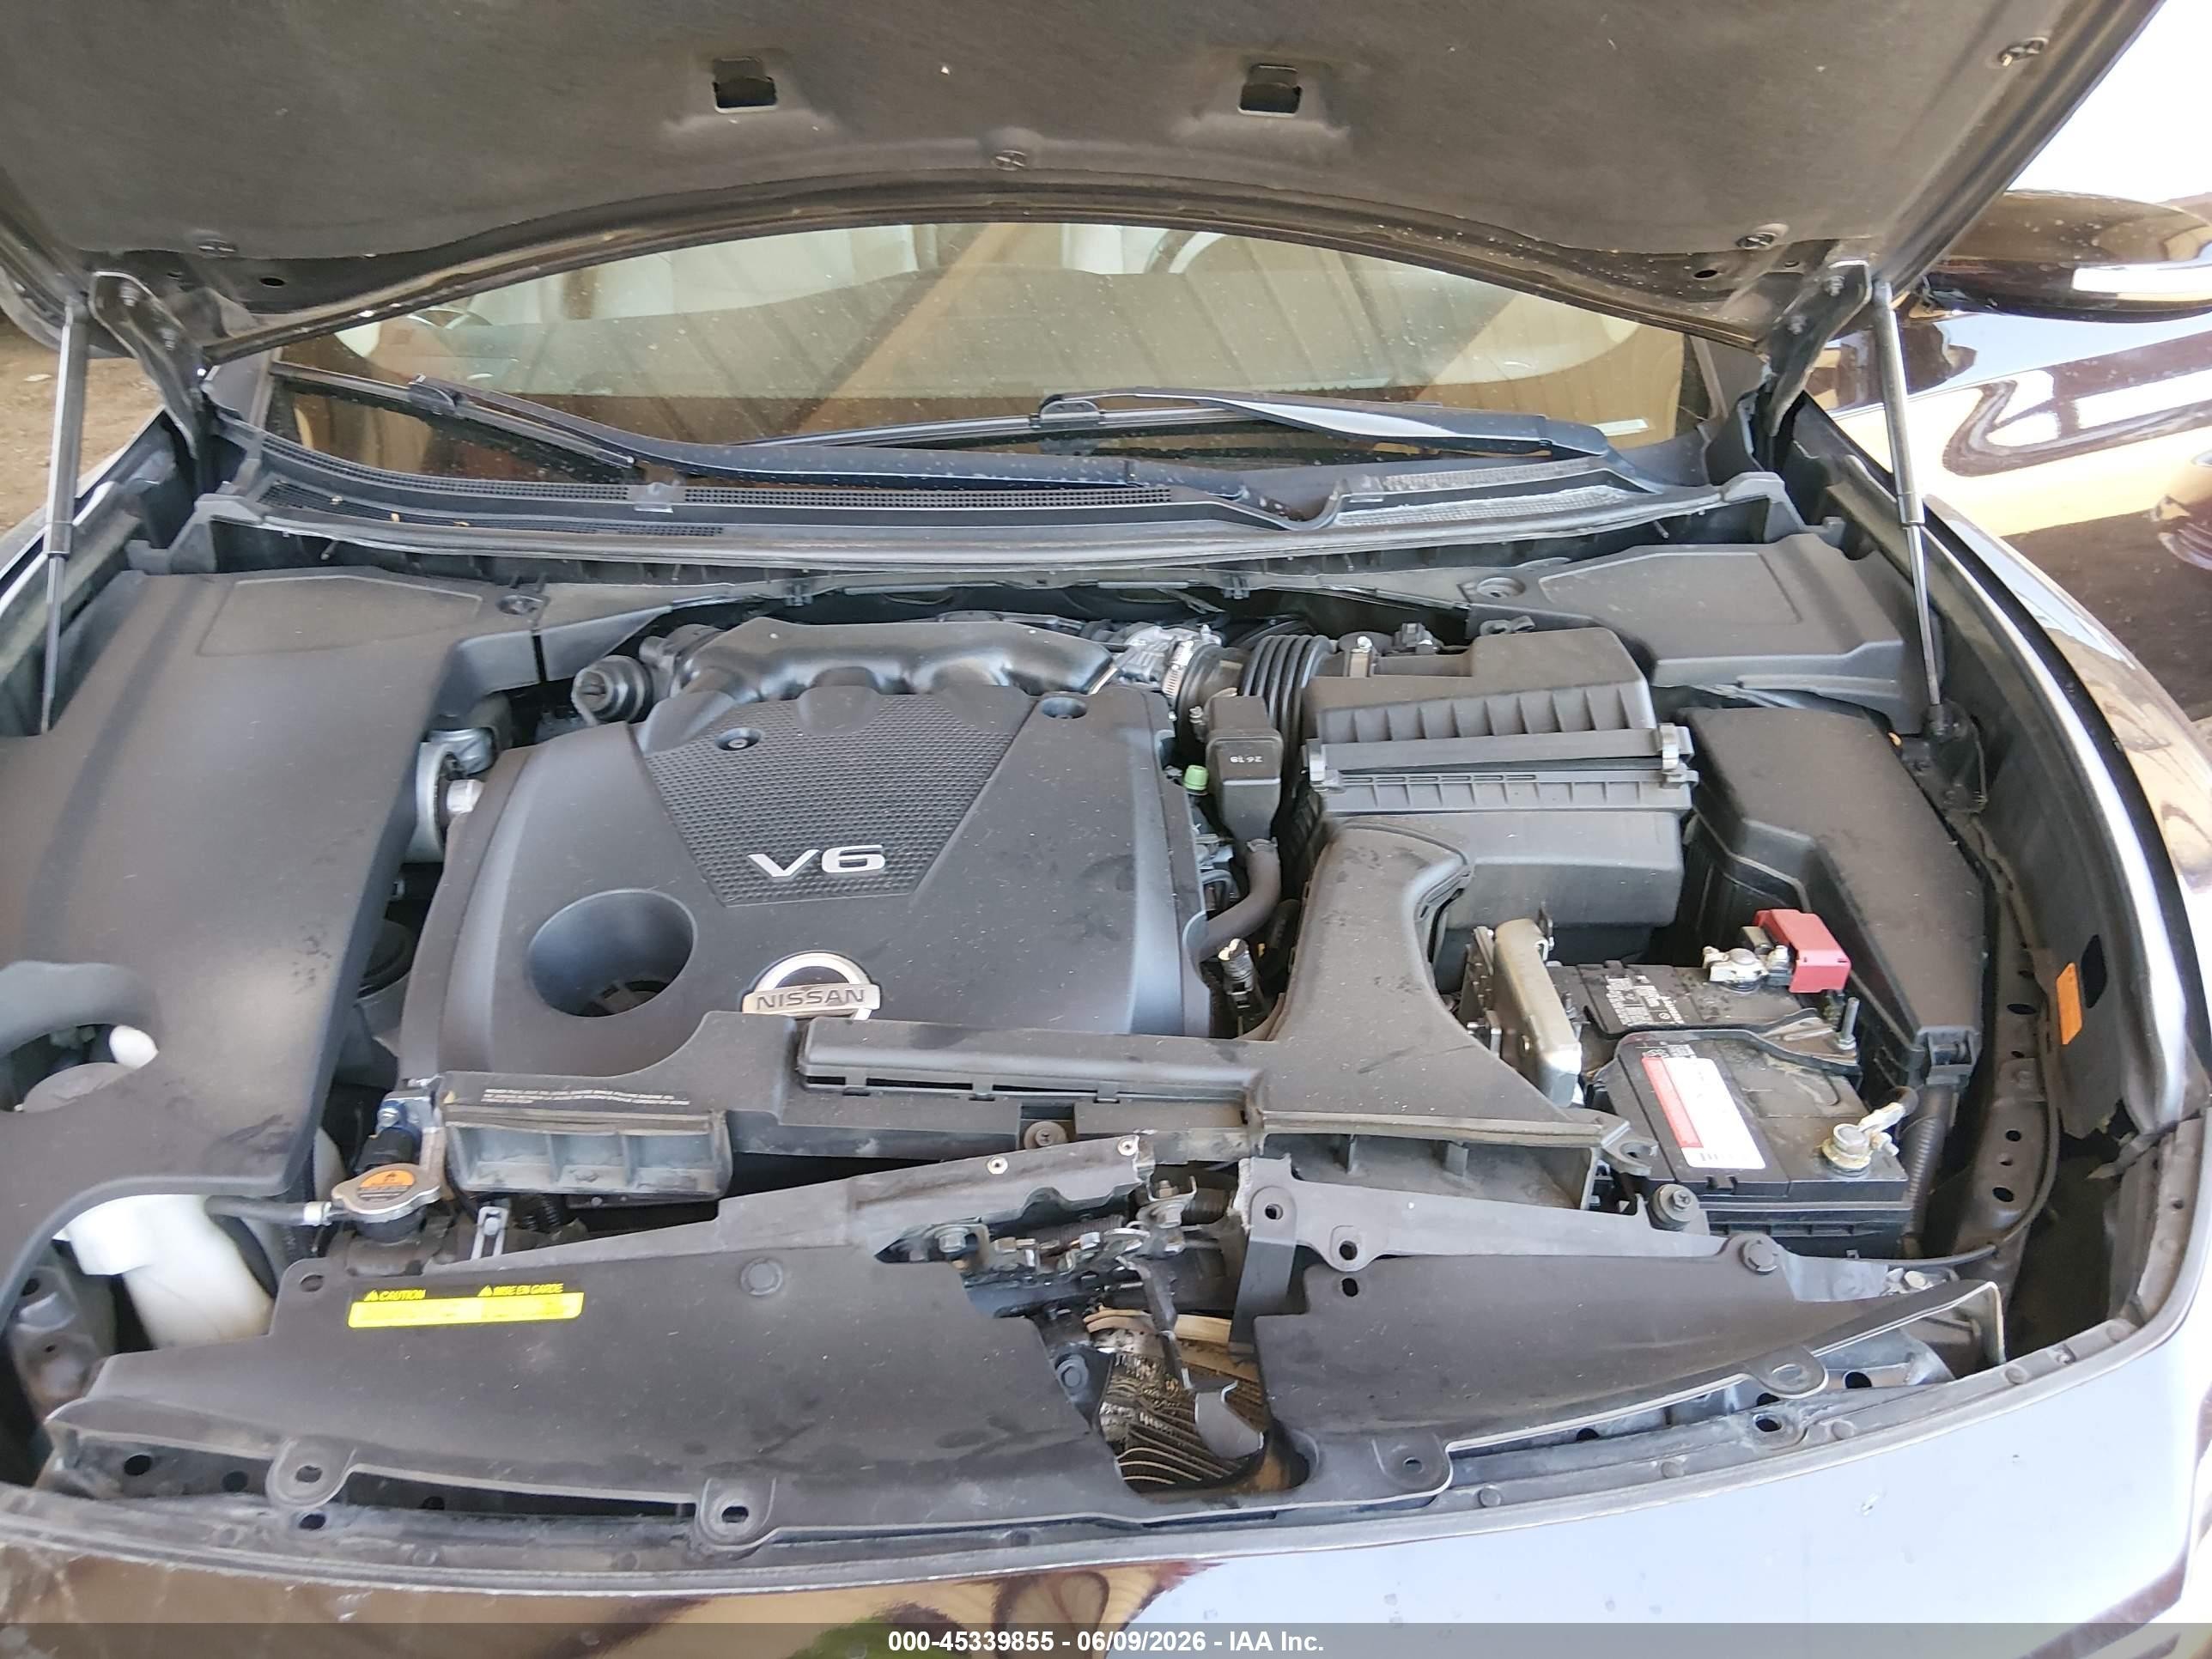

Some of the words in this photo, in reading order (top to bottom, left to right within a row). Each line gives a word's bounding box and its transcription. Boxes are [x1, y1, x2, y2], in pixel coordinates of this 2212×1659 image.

[747, 844, 885, 878] V6
[756, 988, 866, 1011] NISSAN
[379, 1290, 427, 1301] CAUTION
